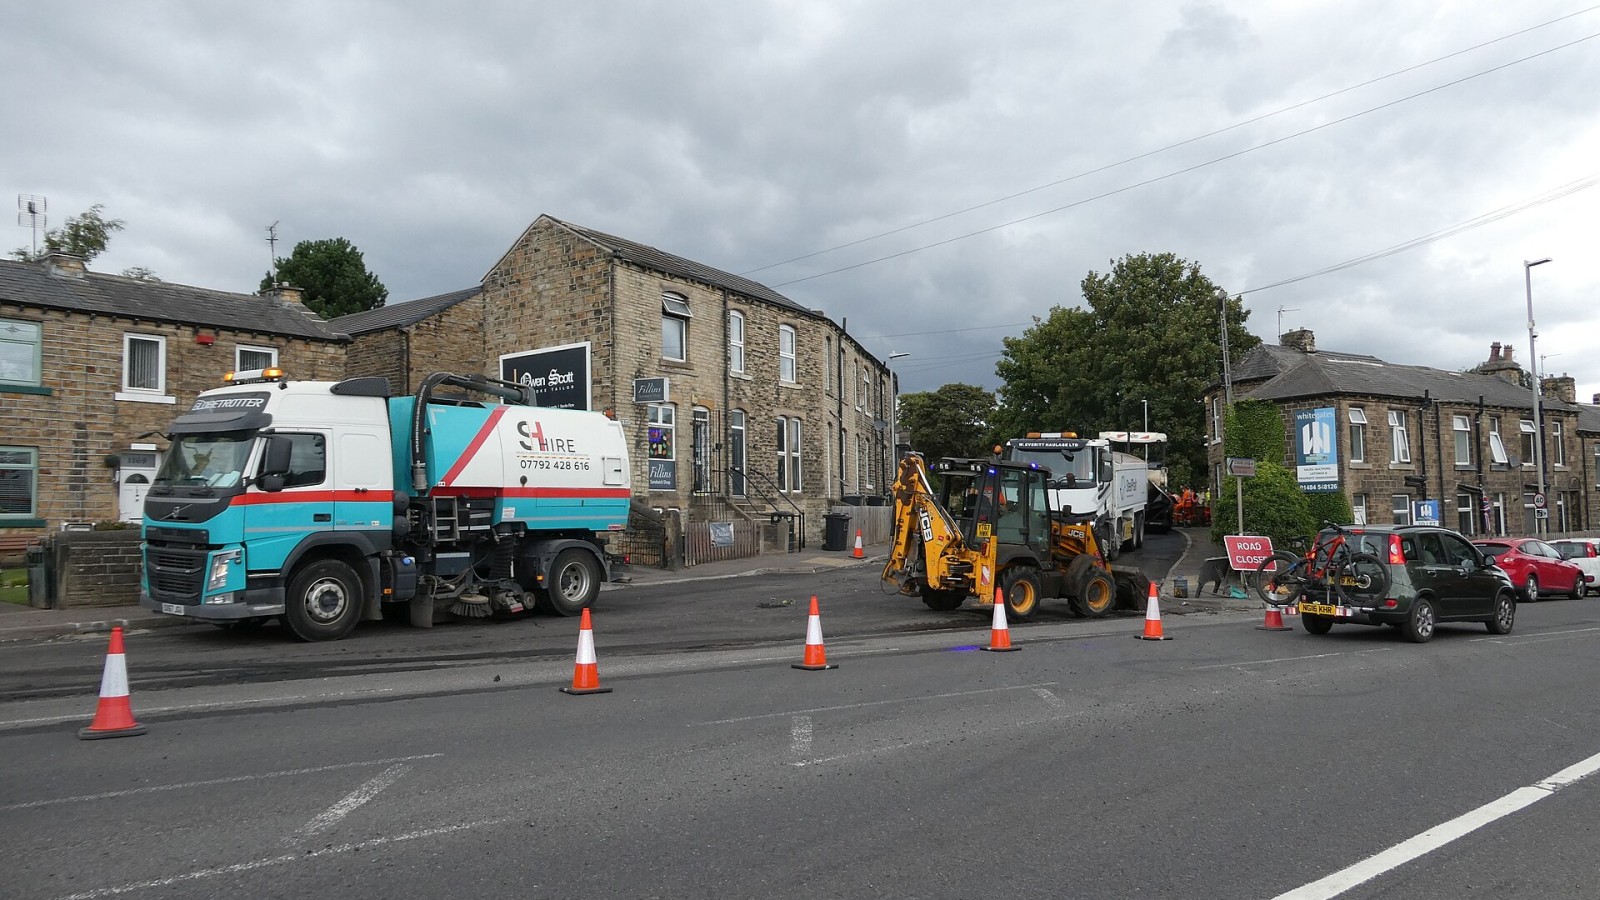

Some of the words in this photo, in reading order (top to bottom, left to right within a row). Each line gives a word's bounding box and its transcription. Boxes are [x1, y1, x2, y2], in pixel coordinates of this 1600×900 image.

[520, 372, 546, 387] Owen
[548, 369, 574, 387] Scott
[638, 382, 662, 394] Fillins
[191, 398, 265, 411] GLOBETROTTER
[1296, 412, 1334, 420] whitegates
[520, 459, 551, 470] 07792
[553, 461, 571, 470] 428
[574, 461, 590, 471] 616
[650, 463, 672, 478] Fillins
[920, 507, 934, 542] JCB
[1067, 529, 1085, 539] JCB
[1236, 542, 1262, 551] ROAD
[1235, 555, 1268, 564] CLOSE
[1318, 606, 1332, 614] KHR
